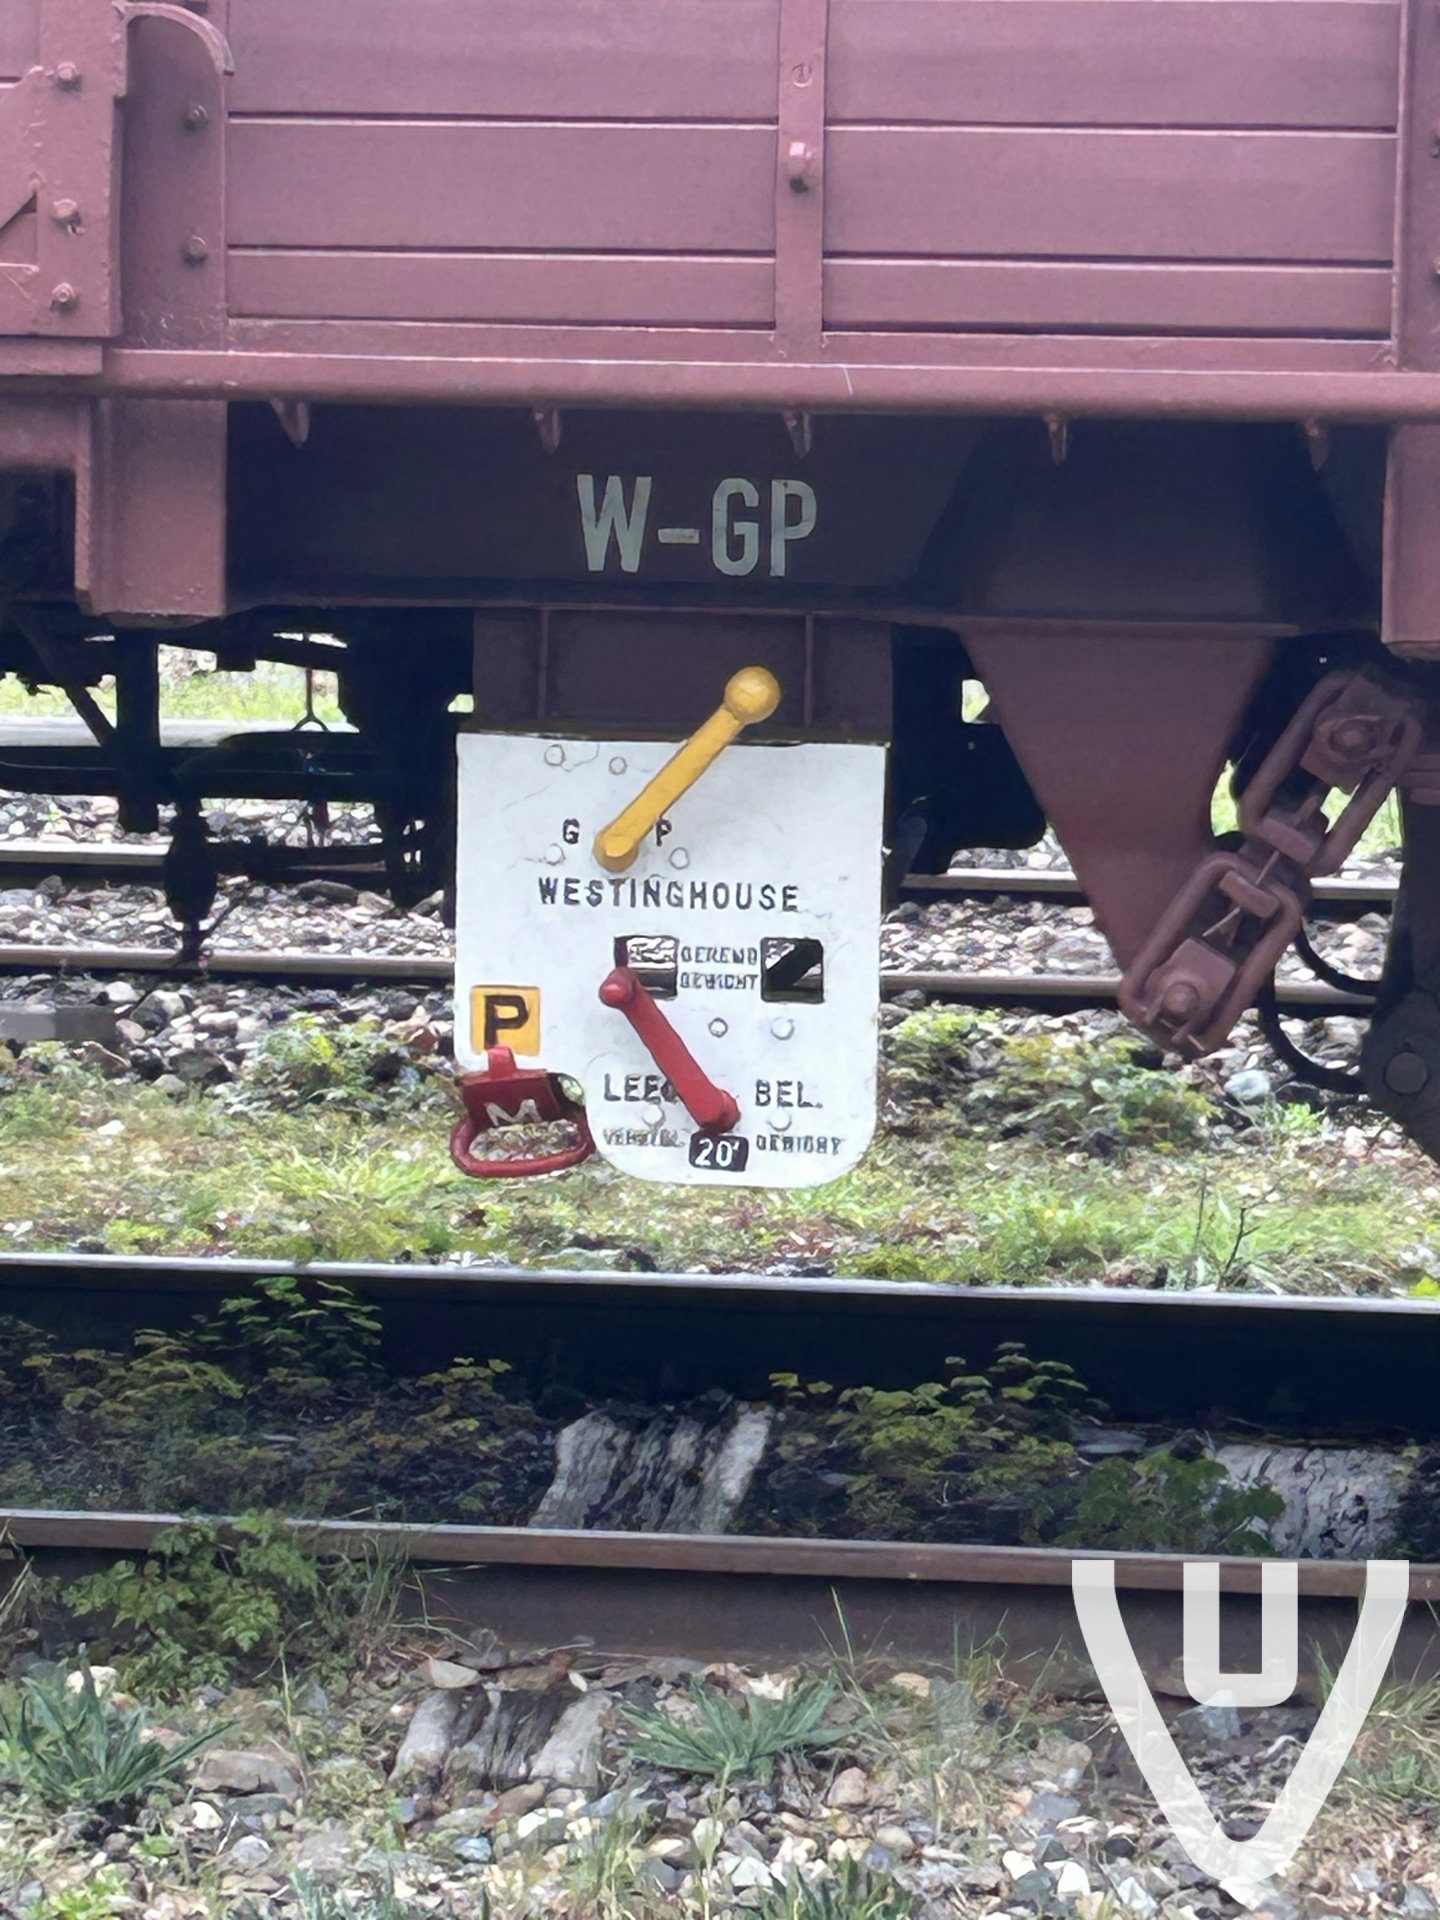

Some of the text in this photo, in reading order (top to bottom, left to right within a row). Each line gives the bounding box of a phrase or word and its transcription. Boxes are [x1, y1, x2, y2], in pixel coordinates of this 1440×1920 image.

[576, 474, 817, 577] W-GP
[562, 819, 672, 846] G P
[538, 877, 799, 911] WESTINGHOUSE
[484, 995, 528, 1049] P
[756, 1080, 822, 1108] BEL.
[485, 1098, 541, 1126] M
